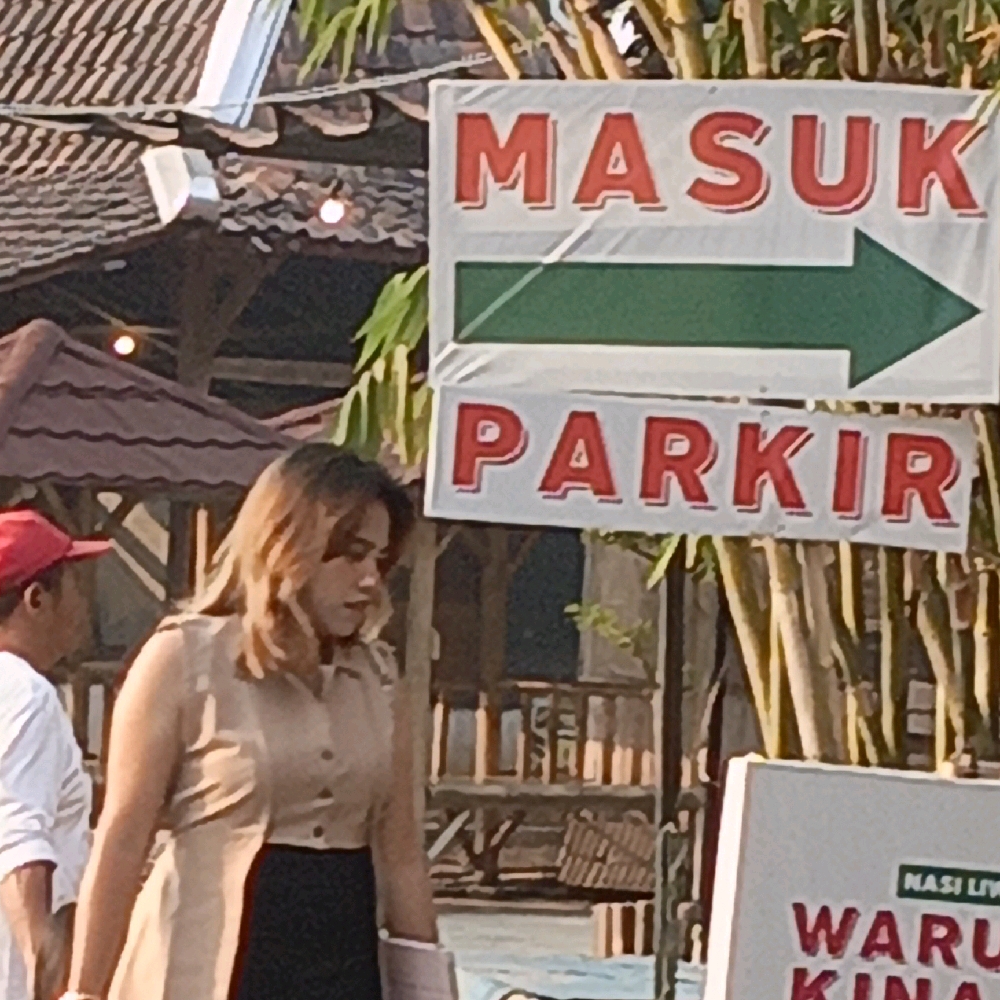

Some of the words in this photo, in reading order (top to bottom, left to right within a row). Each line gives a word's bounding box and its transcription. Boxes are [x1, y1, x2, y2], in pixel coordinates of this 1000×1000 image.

[454, 110, 988, 217] MASUK
[451, 402, 961, 527] PARKIR
[904, 872, 962, 896] NASI
